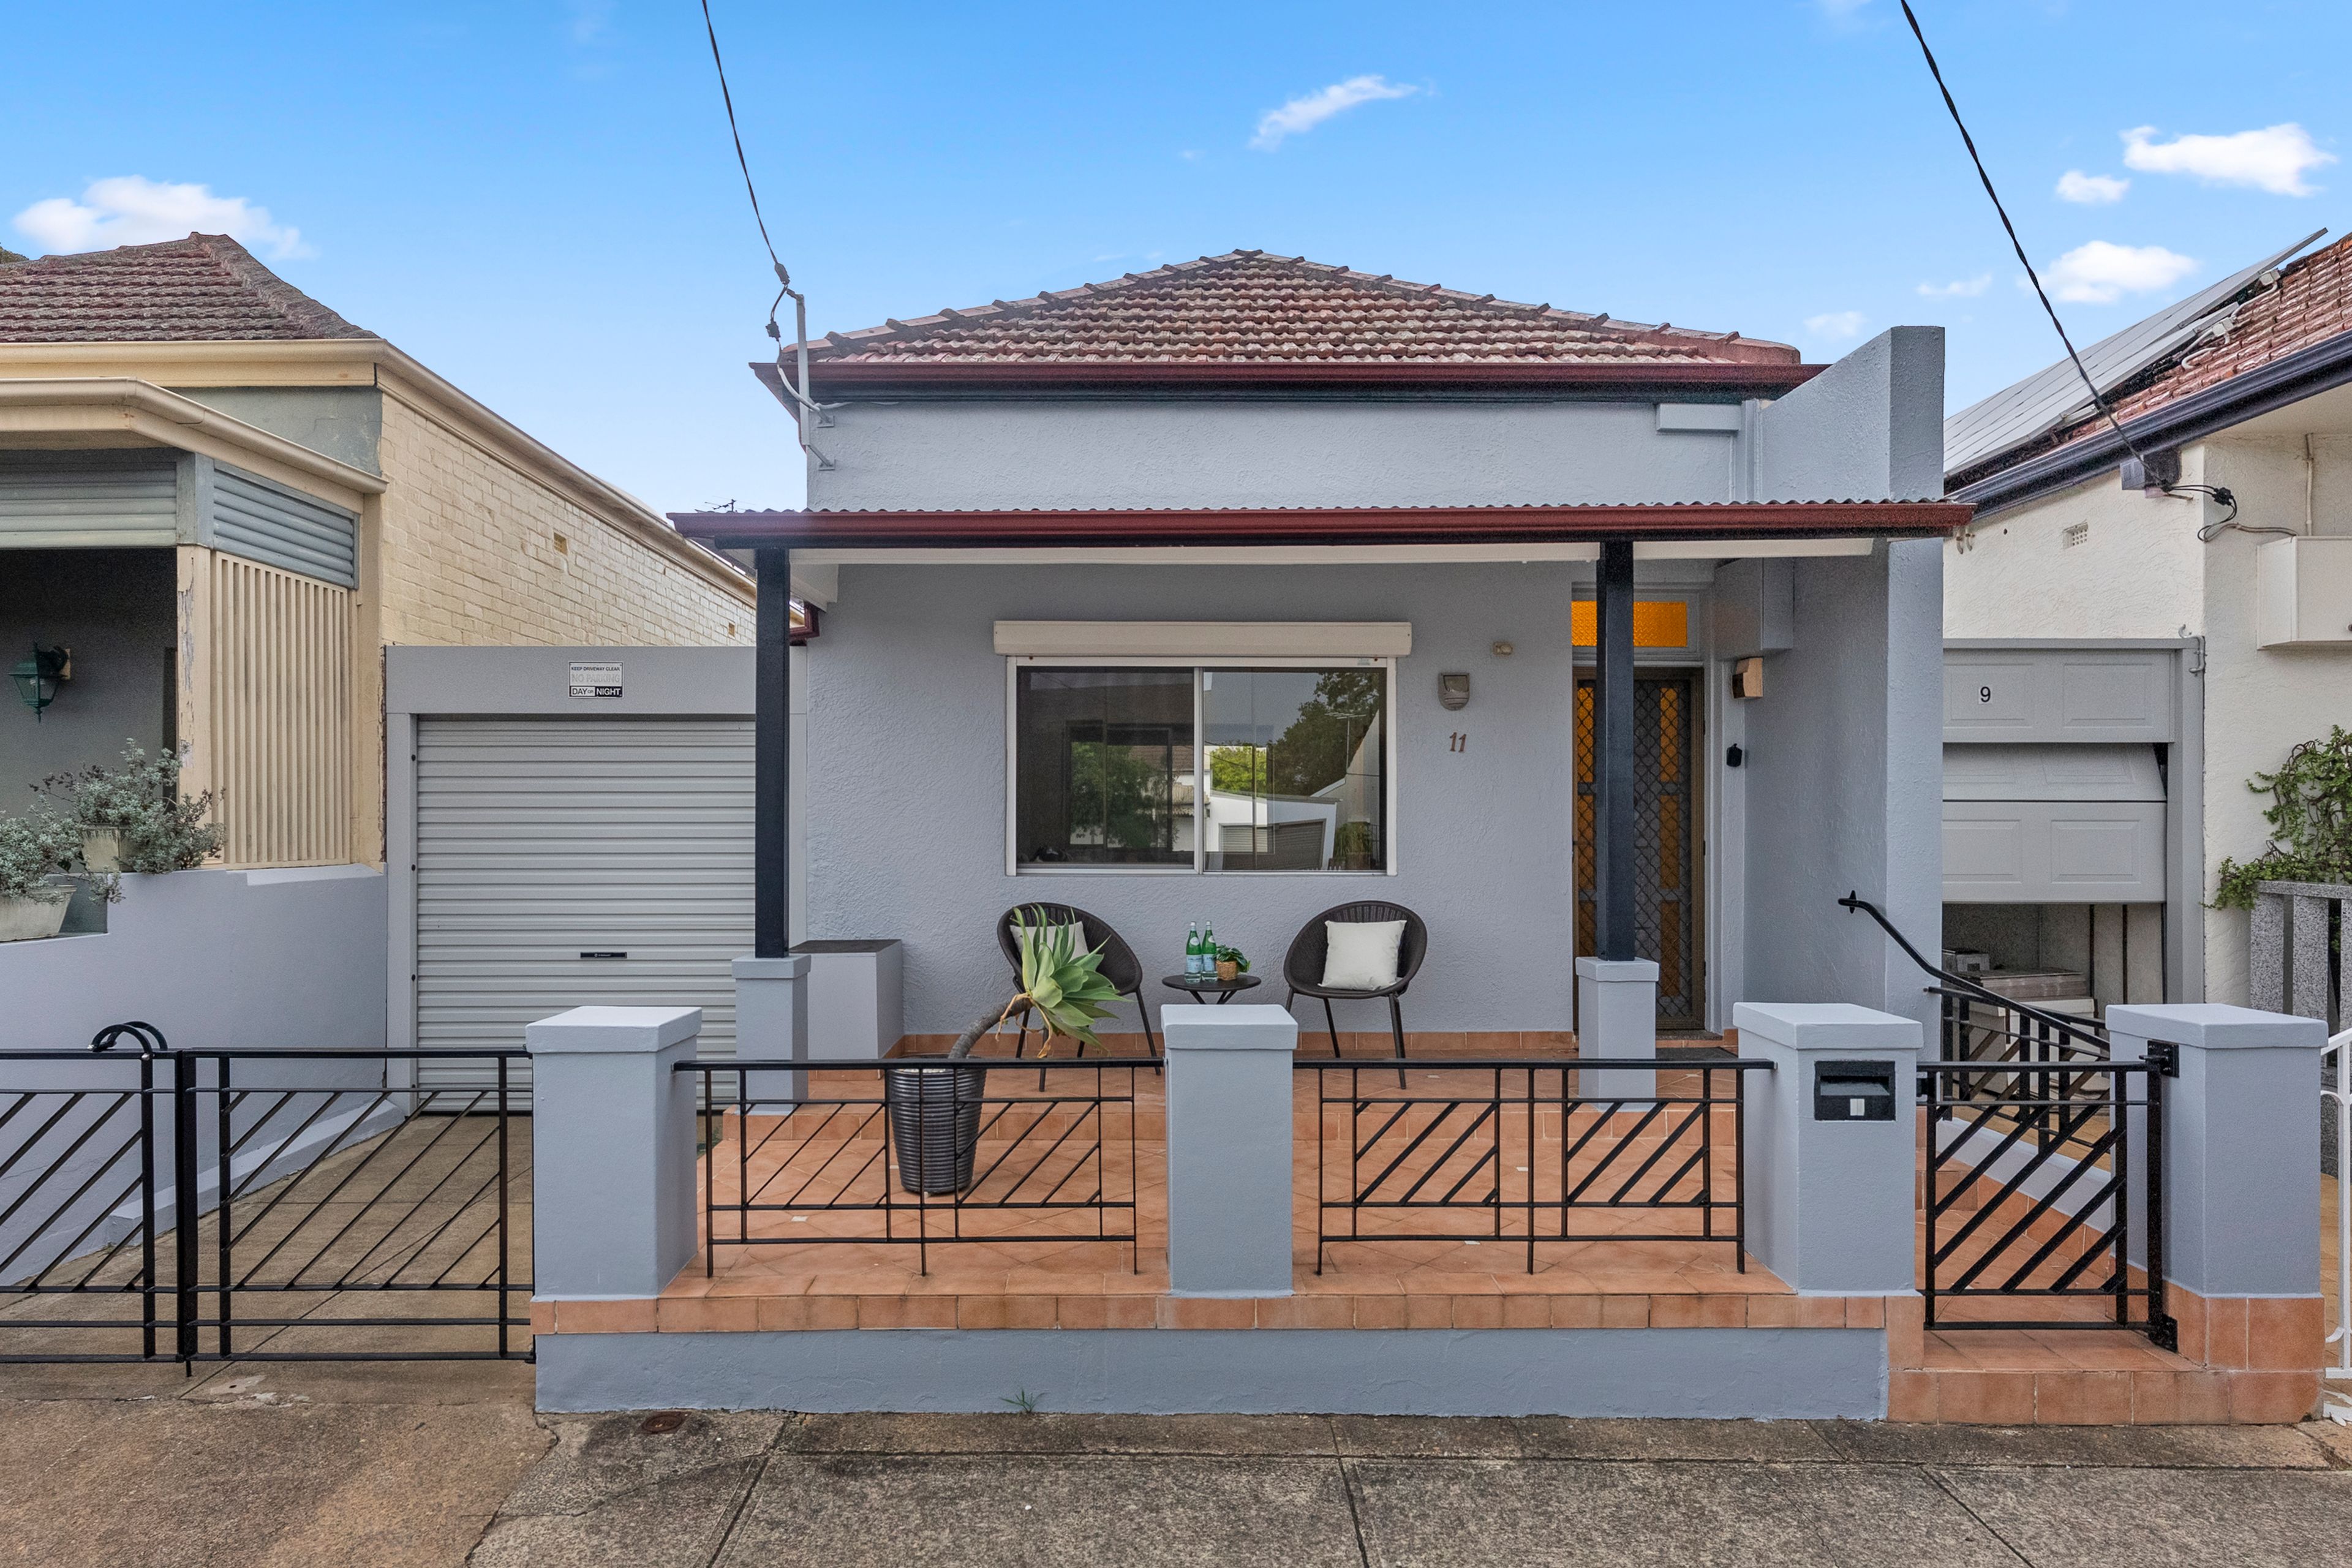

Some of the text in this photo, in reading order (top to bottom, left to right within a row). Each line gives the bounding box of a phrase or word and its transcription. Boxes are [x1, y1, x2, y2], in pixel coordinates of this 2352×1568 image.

[571, 674, 620, 682] NO PARKING
[1980, 686, 1991, 703] 9
[1449, 732, 1467, 753] 11
